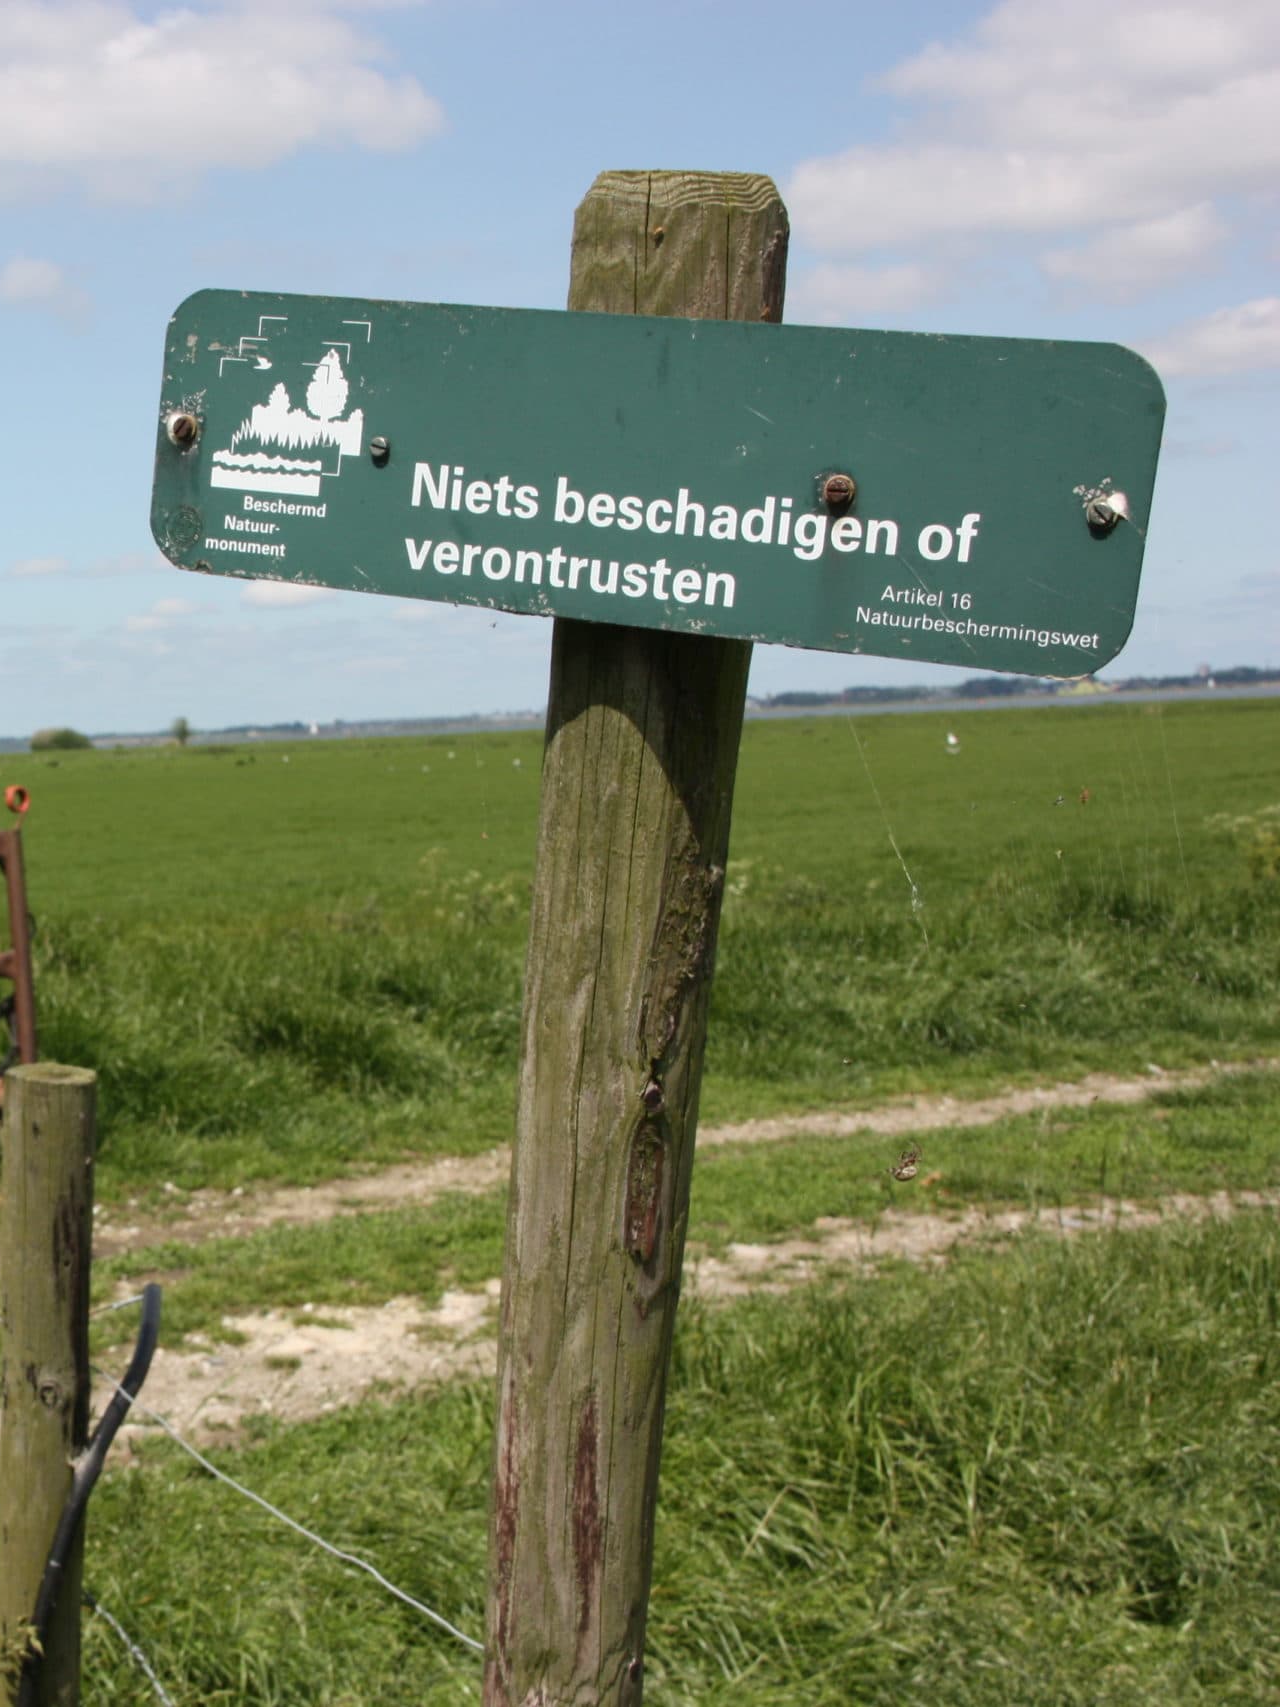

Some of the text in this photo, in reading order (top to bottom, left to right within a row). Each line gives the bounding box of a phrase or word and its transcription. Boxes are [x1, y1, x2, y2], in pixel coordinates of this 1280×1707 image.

[243, 495, 327, 518] Beschermd
[411, 462, 981, 563] Niets beschadigen of
[224, 515, 281, 534] Natuur-
[205, 537, 287, 557] monument
[405, 537, 736, 608] verontrusten
[880, 585, 972, 610] Artikel 16
[856, 606, 1099, 649] Natuurbeschermingswet
